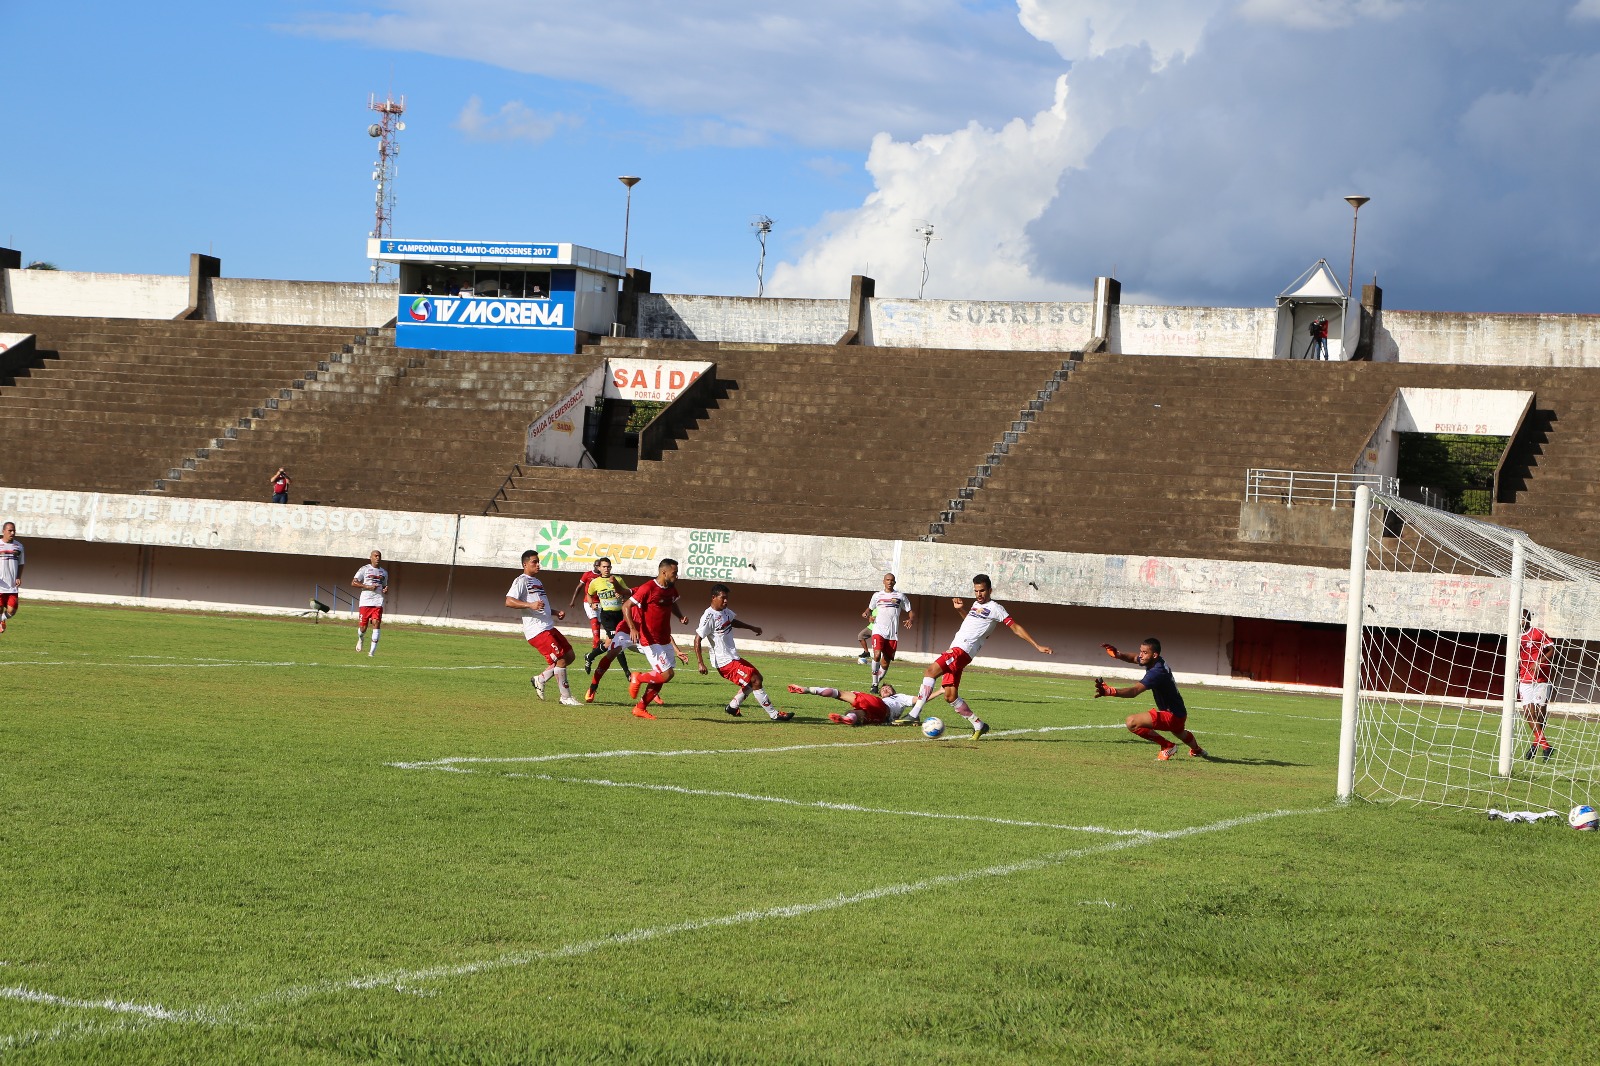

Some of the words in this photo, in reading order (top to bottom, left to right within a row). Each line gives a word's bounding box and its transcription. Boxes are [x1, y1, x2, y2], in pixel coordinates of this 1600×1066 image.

[397, 244, 448, 253] CAMPEONATO
[449, 246, 532, 256] SUL-MATO-GROSSENSE
[533, 247, 551, 256] 2017
[434, 300, 460, 323] TV
[458, 300, 564, 326] MORENA
[665, 392, 676, 401] 26
[1474, 424, 1488, 434] 25
[689, 530, 731, 544] GENTE
[687, 543, 715, 555] QUE
[687, 555, 748, 569] COOPERA
[686, 566, 736, 580] CRESCE.
